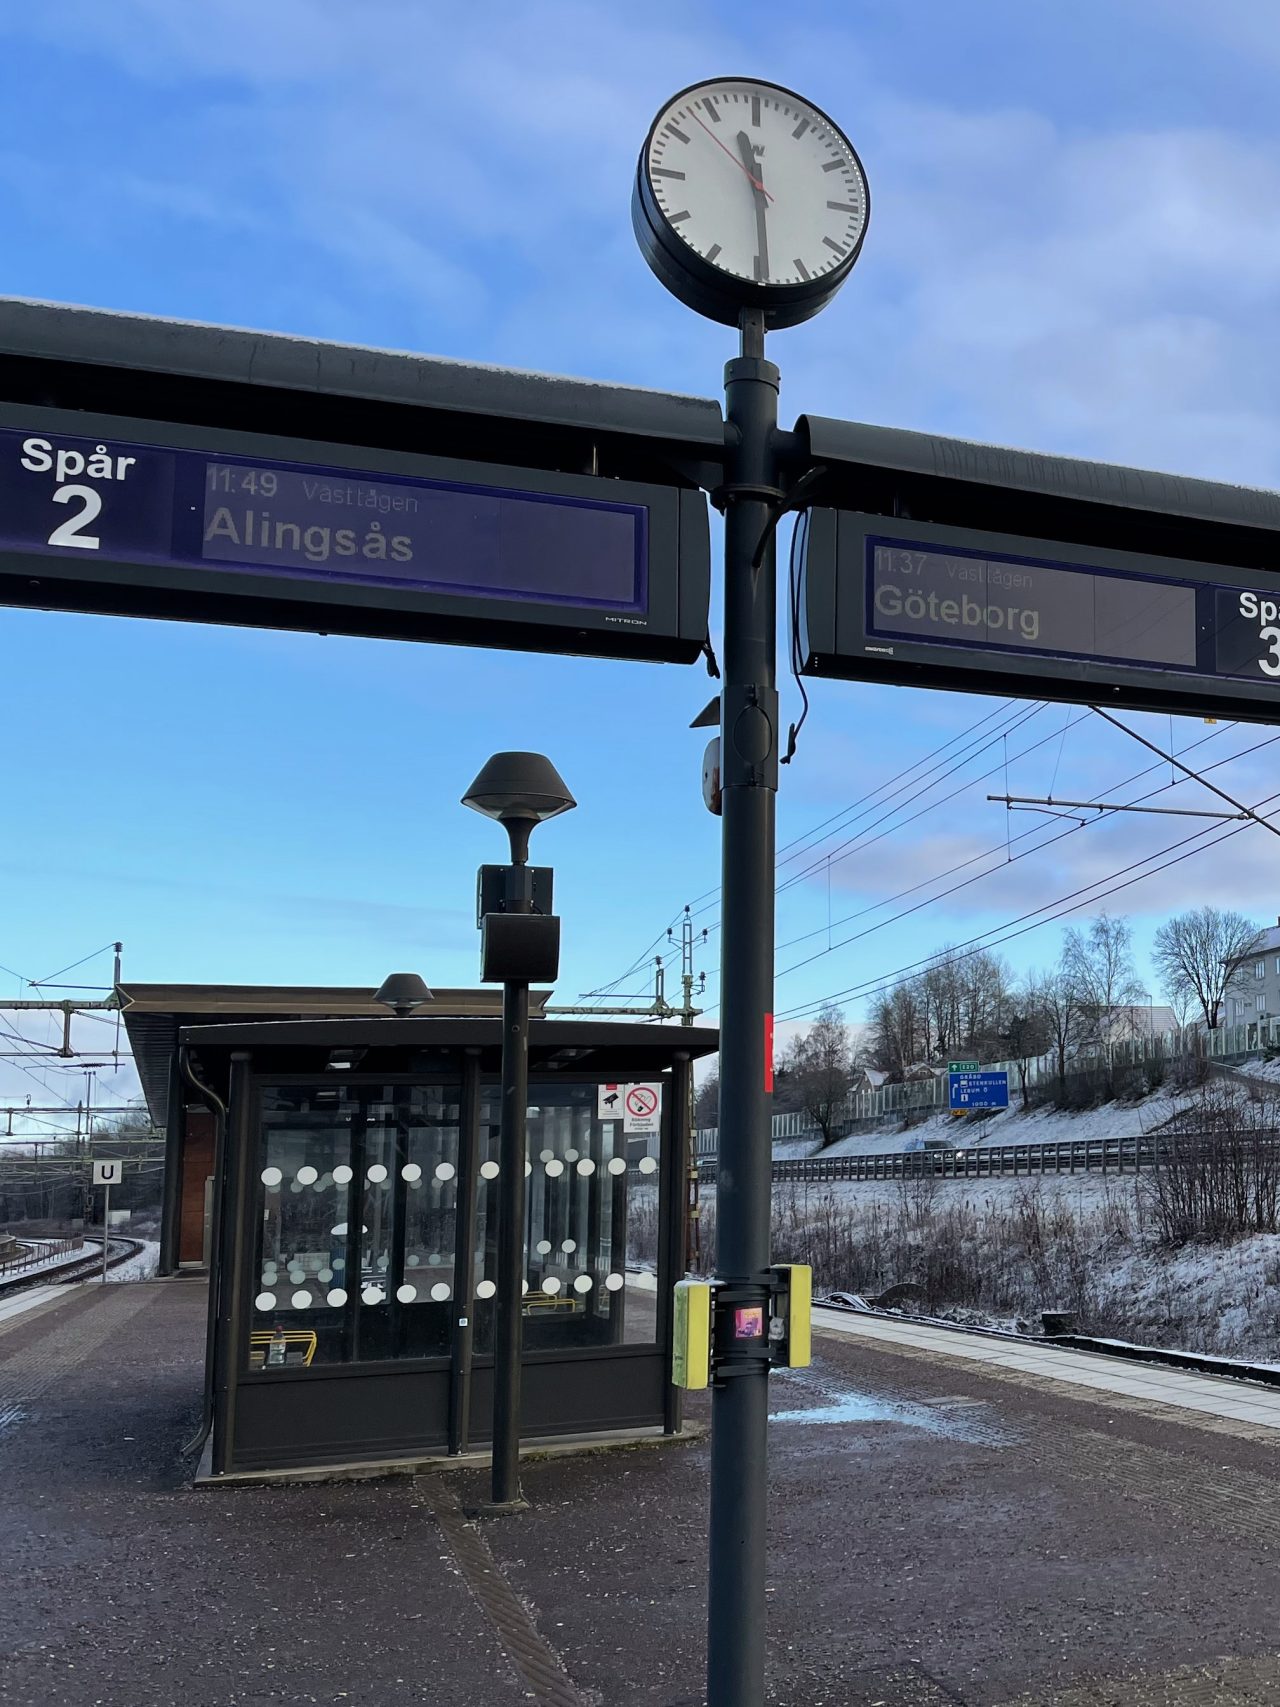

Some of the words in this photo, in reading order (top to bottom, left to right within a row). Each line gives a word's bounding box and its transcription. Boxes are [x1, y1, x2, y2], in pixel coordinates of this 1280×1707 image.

[21, 438, 136, 482] Spår
[207, 467, 278, 497] 11:49
[48, 484, 102, 550] 2
[205, 507, 414, 562] Alingsås
[605, 616, 647, 626] MITRON
[874, 584, 1039, 640] Göteborg
[101, 1165, 114, 1180] U
